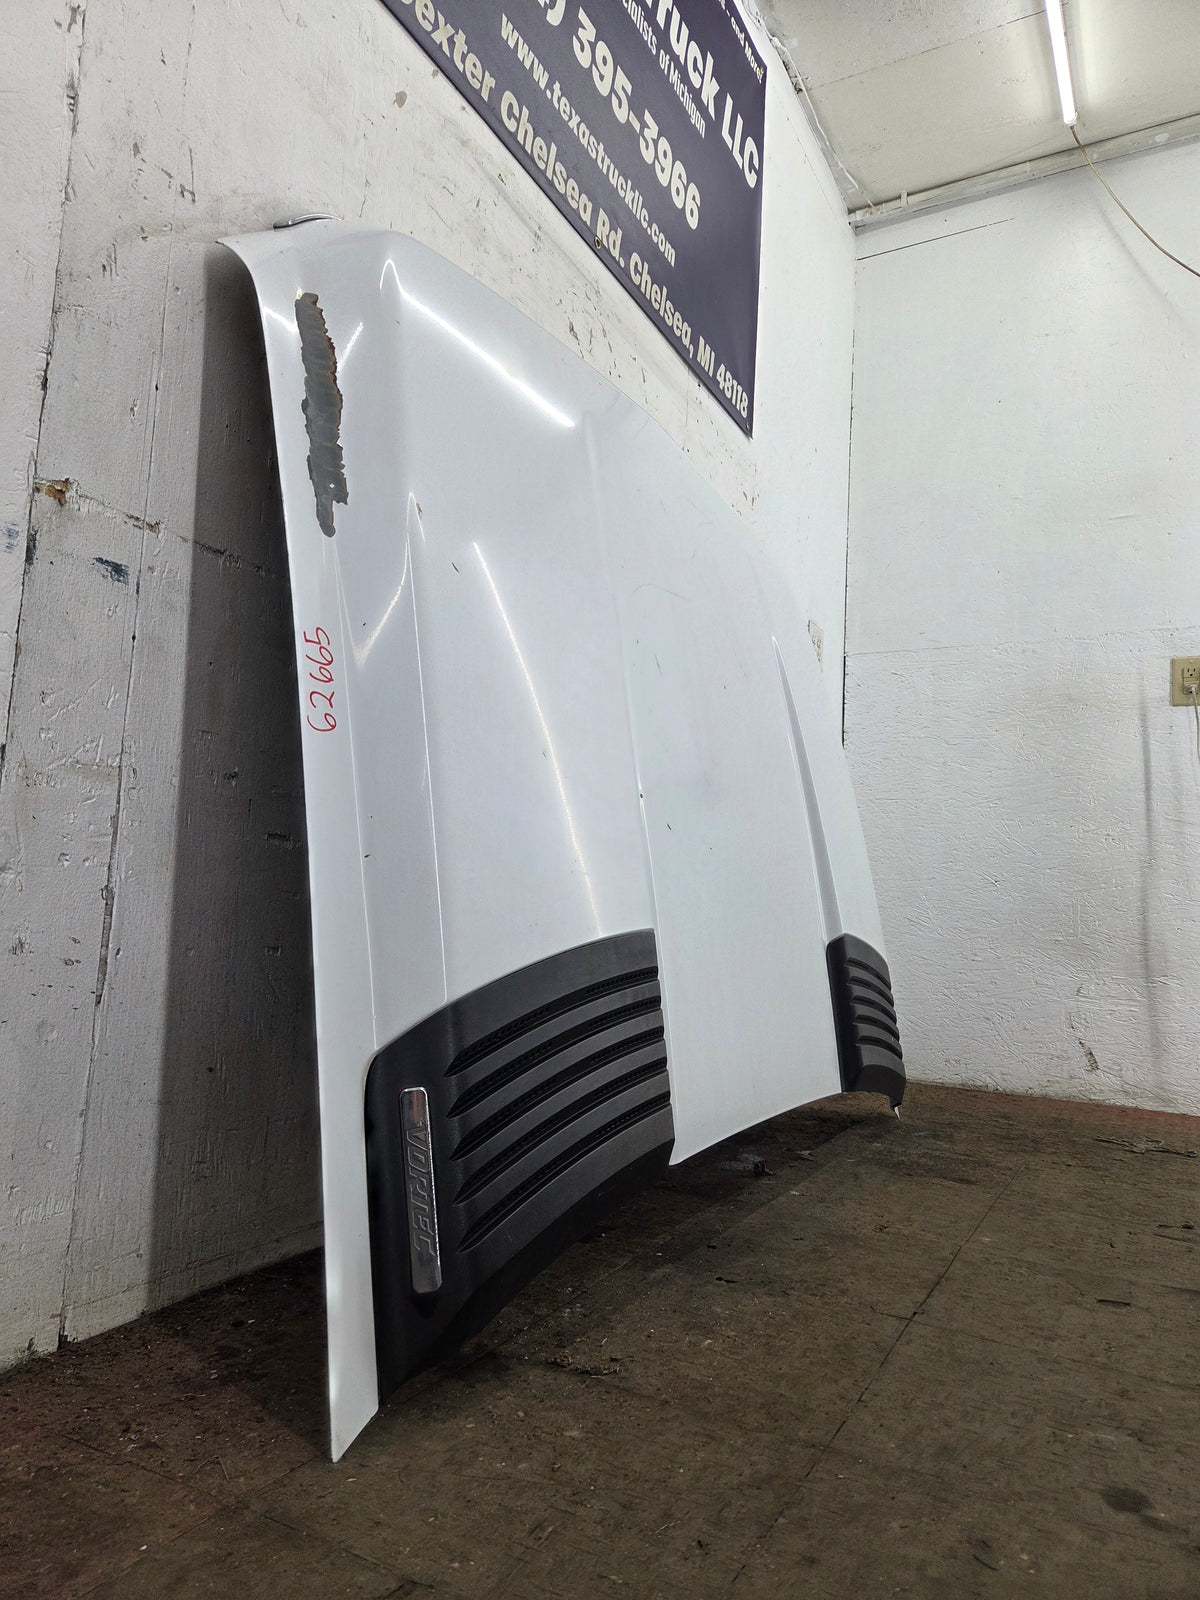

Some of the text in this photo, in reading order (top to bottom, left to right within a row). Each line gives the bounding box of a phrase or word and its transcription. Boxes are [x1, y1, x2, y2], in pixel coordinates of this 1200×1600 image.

[645, 0, 759, 189] ruck LLC
[659, 48, 670, 75] of
[669, 61, 706, 139] Michigan
[731, 16, 745, 48] and
[501, 13, 676, 268] www.texastruckllc.com
[572, 6, 701, 230] 395-3966
[402, 0, 749, 419] exter Chelsea Rd. Chelsea, MI 48118
[303, 626, 337, 732] 62665
[406, 1120, 436, 1258] VORTEC
